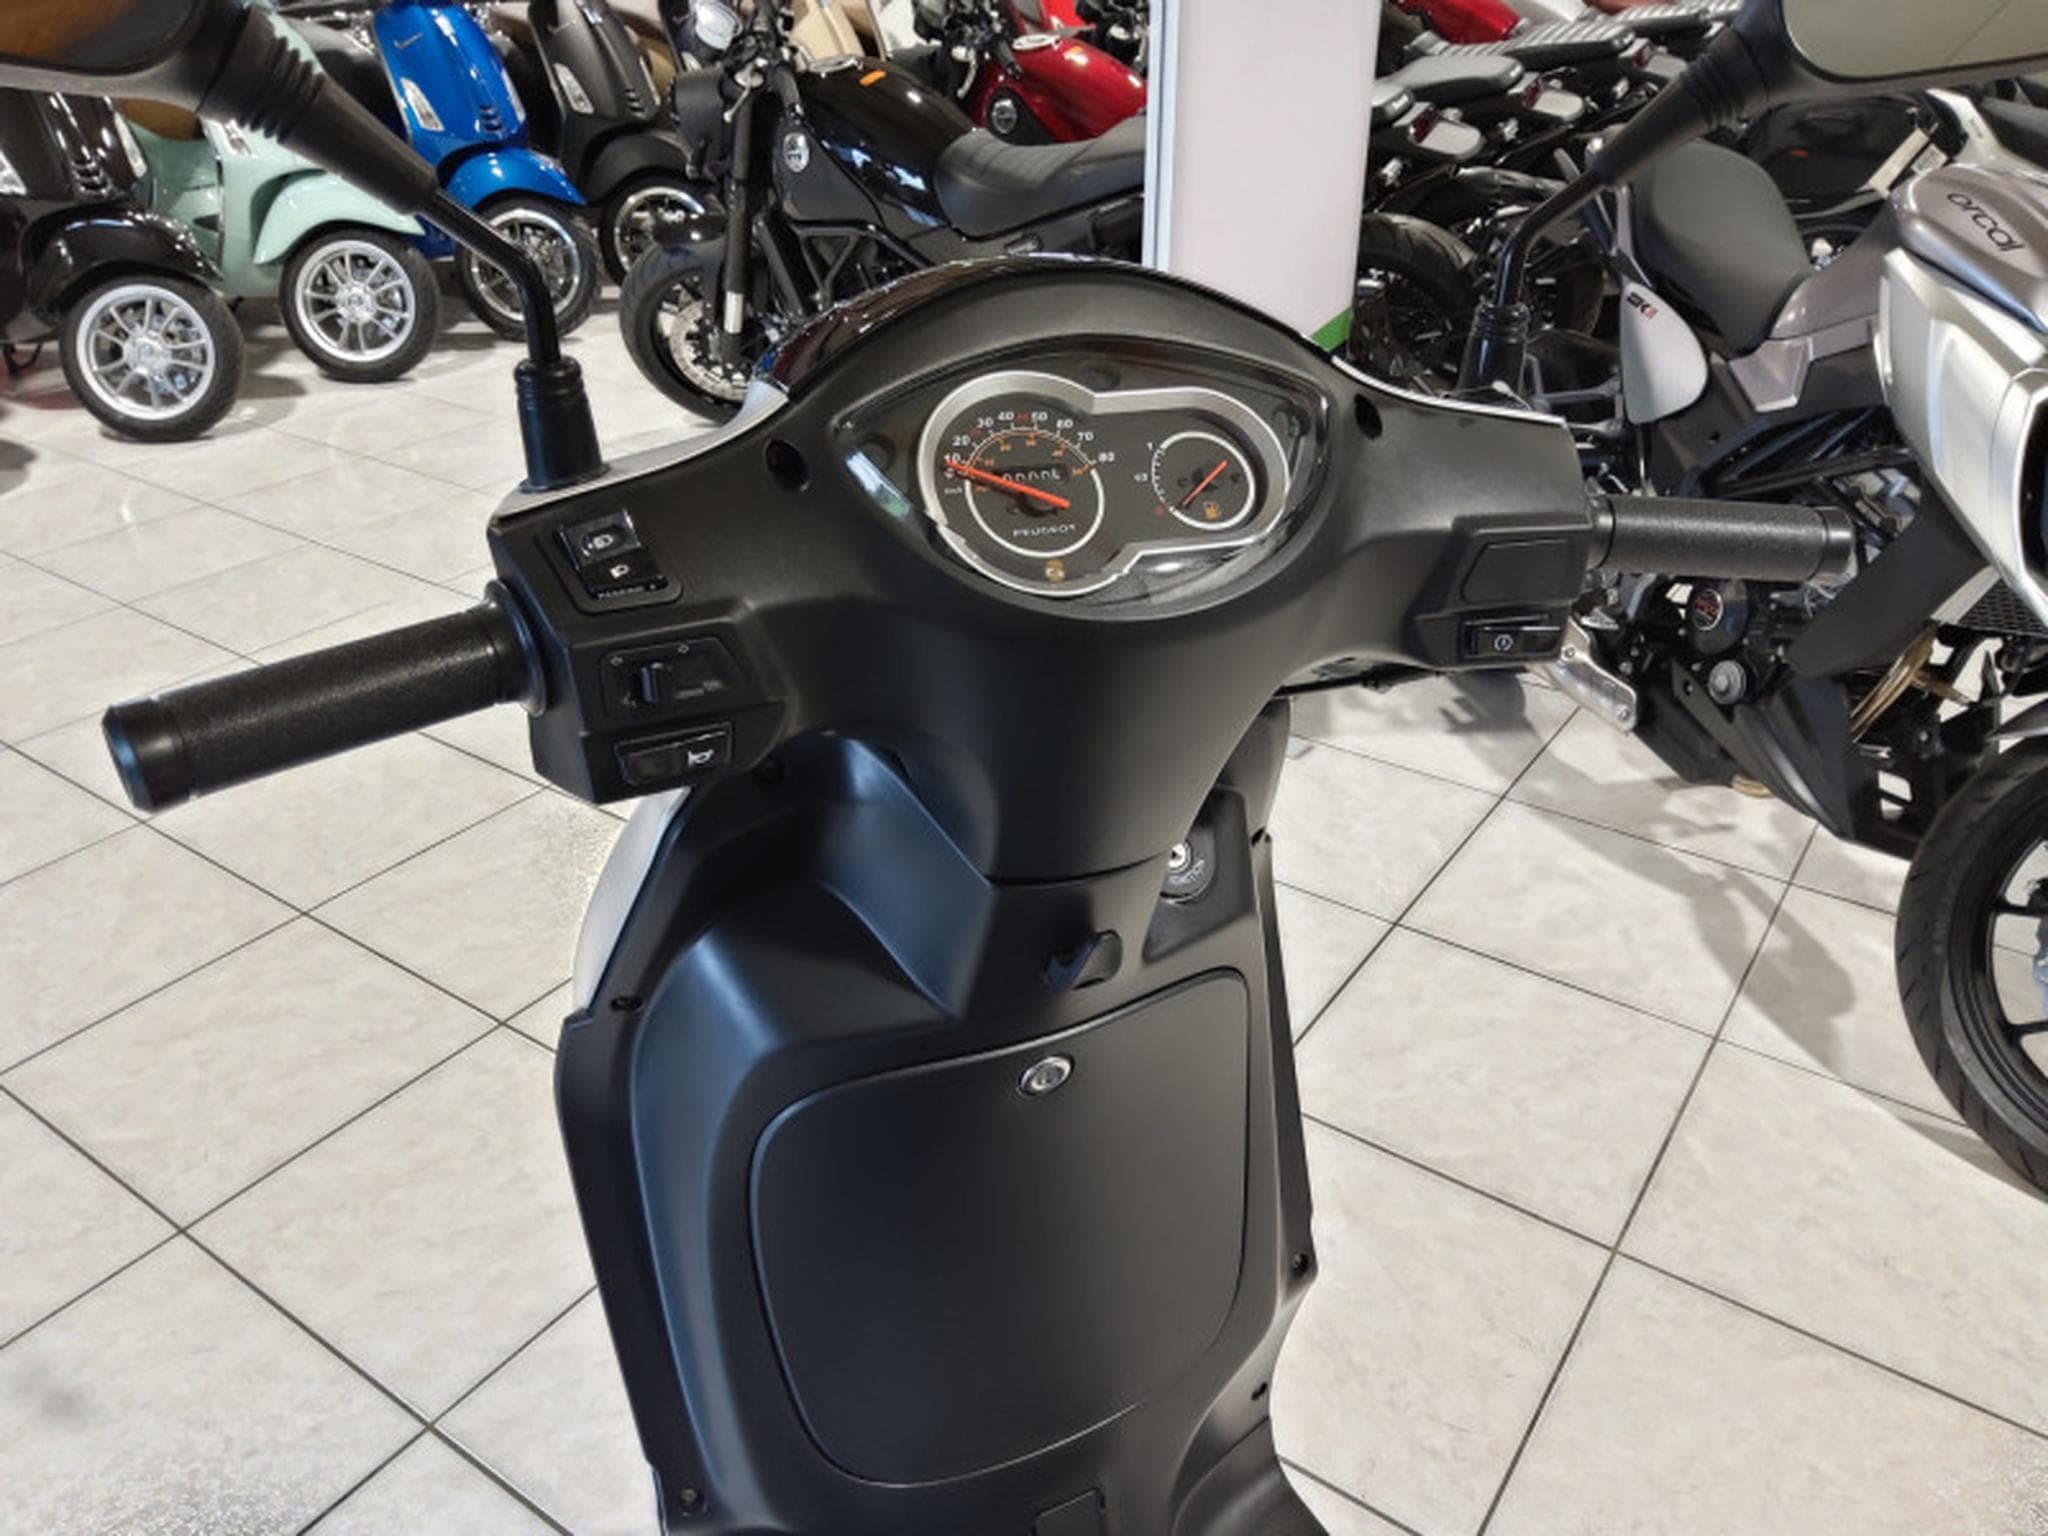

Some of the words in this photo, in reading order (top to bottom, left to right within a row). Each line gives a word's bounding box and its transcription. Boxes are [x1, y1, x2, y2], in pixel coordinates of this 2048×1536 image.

[1946, 192, 2026, 252] orcal
[998, 410, 1015, 421] 40
[976, 416, 994, 429] 30
[952, 434, 971, 447] 20
[1077, 431, 1095, 442] 70
[1012, 523, 1077, 538] PEUGEOT
